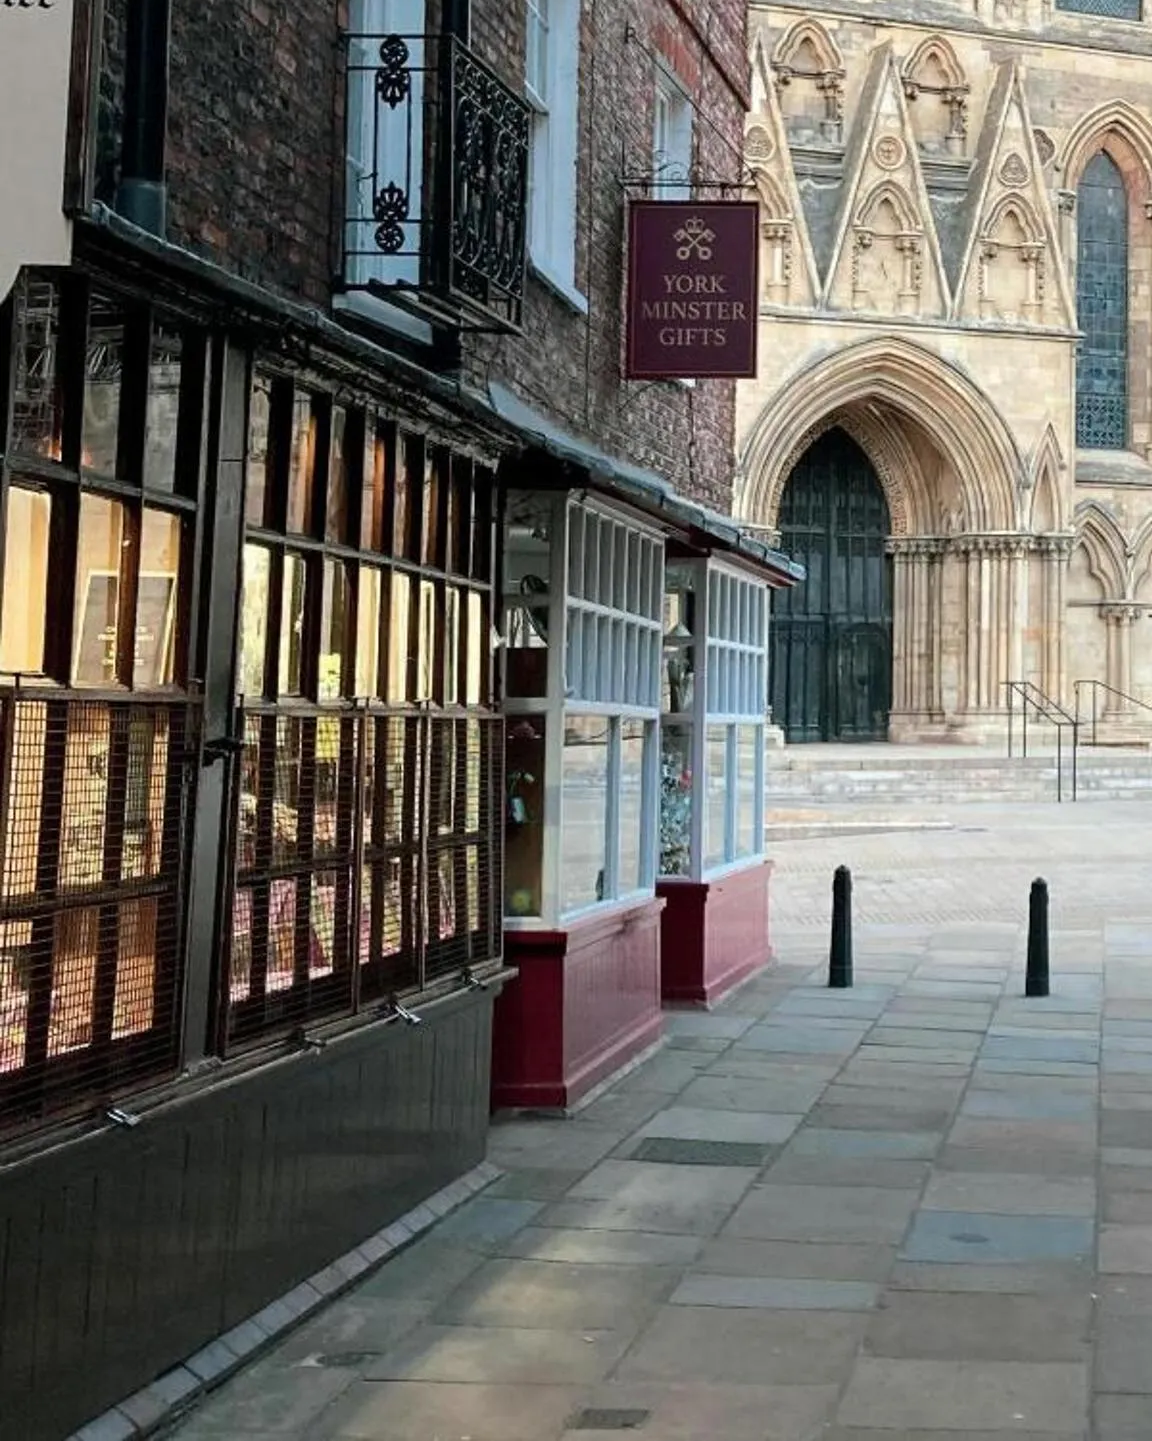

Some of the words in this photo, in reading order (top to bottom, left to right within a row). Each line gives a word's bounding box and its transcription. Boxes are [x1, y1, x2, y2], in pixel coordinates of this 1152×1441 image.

[663, 275, 726, 293] YORK
[642, 302, 746, 320] MINSTER
[659, 328, 726, 346] GIFTS
